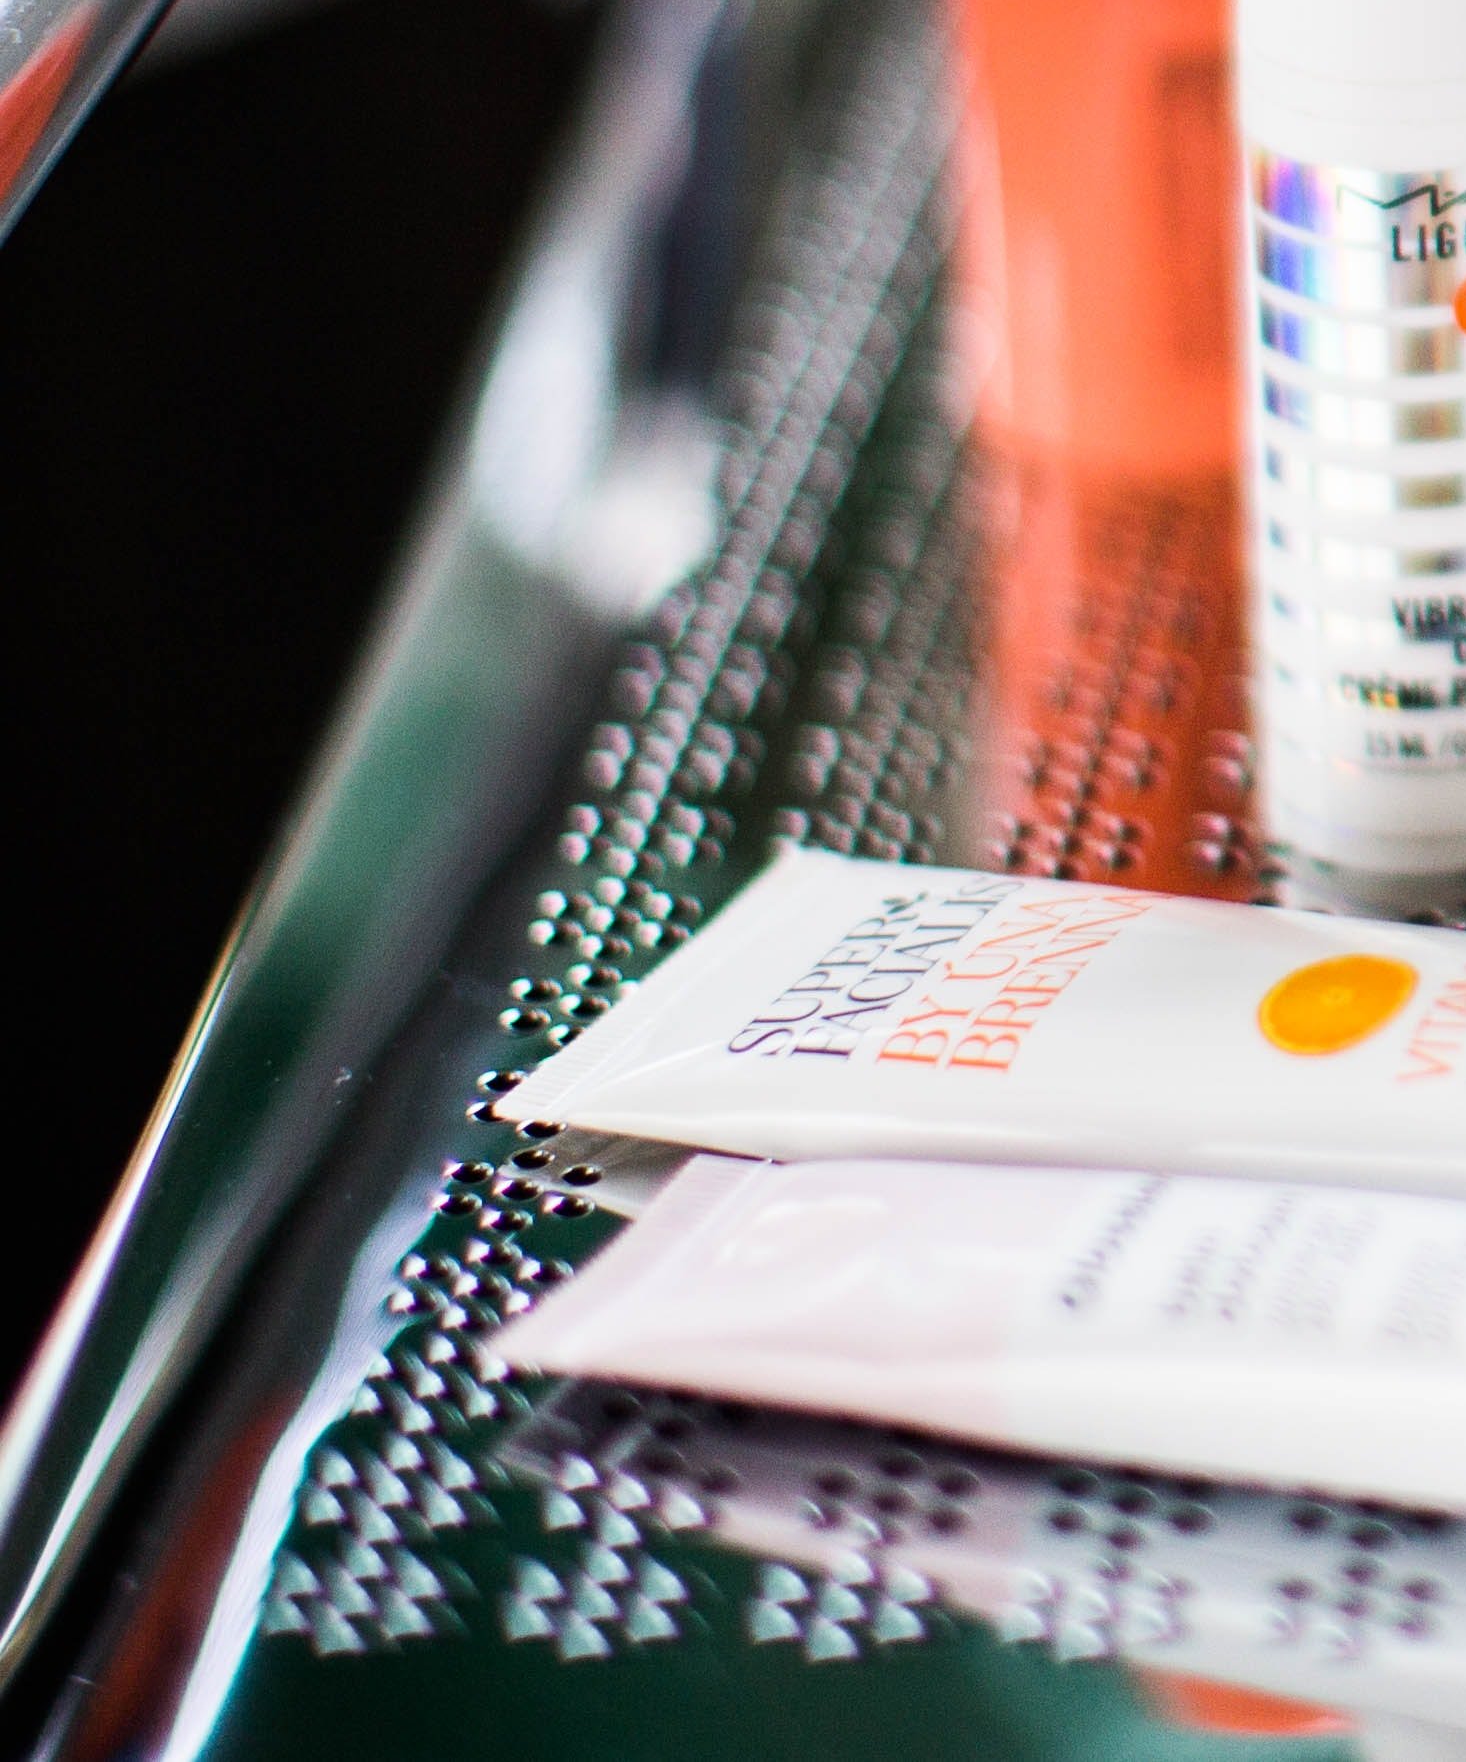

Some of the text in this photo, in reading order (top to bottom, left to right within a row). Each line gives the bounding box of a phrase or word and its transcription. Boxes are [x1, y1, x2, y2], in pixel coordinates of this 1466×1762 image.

[727, 910, 910, 1059] SUPER
[876, 894, 1103, 1068] BY UNA
